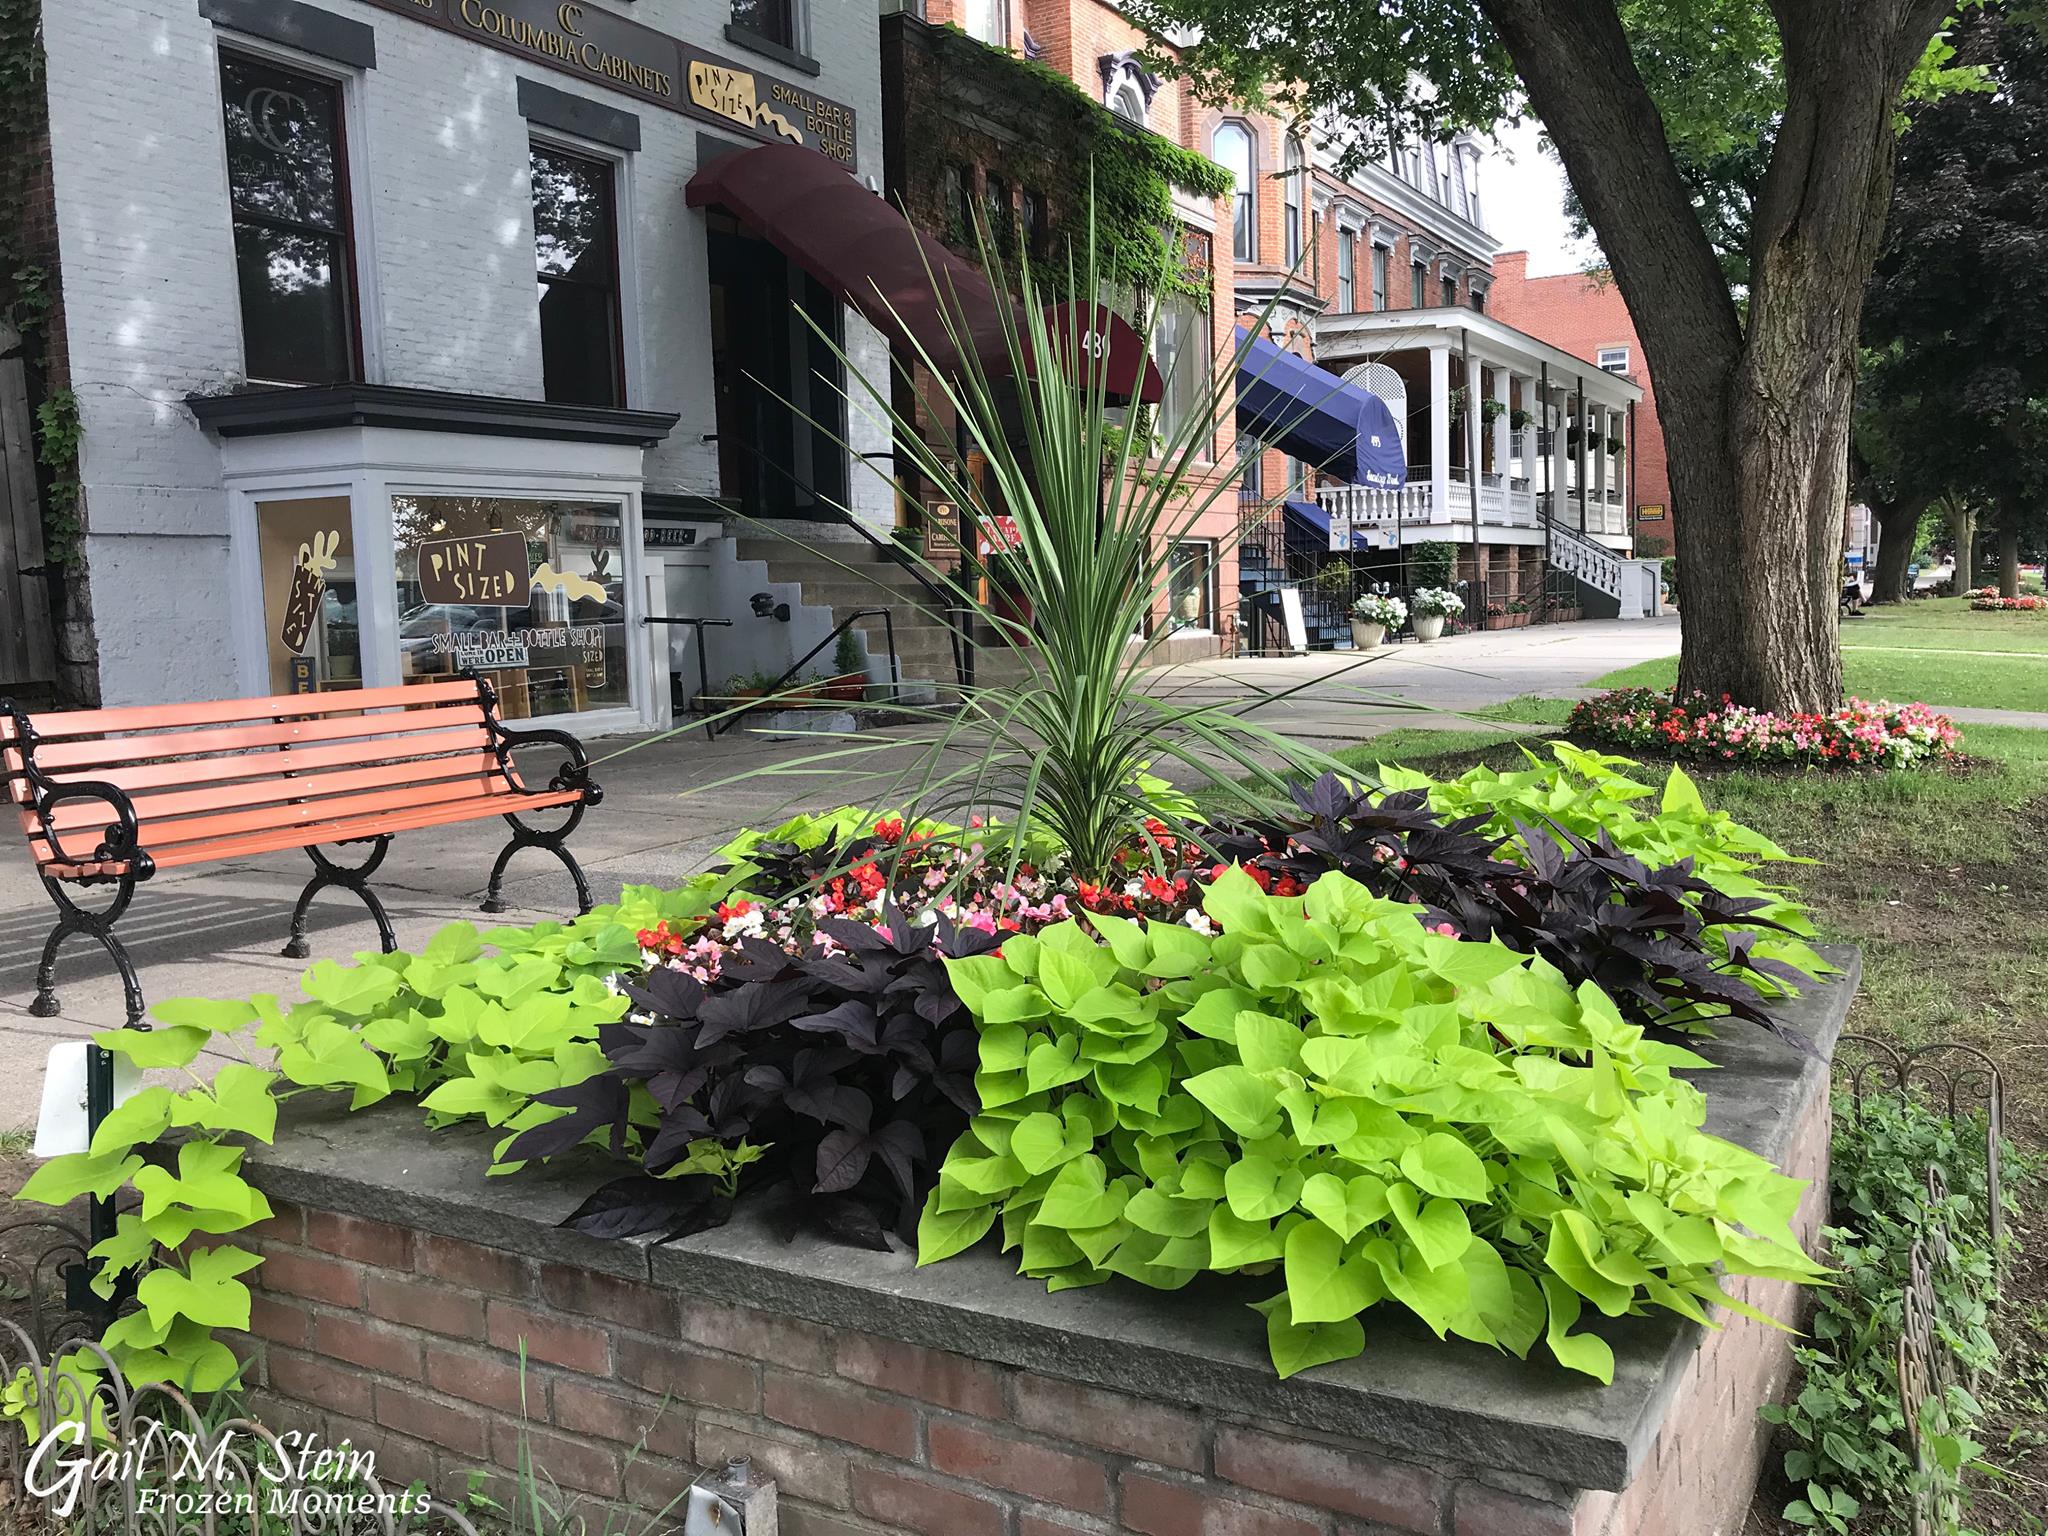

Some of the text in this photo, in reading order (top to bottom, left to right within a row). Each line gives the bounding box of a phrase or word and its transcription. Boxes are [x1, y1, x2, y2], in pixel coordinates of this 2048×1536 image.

[557, 4, 584, 36] CC
[582, 43, 671, 96] CABINETS
[695, 68, 734, 95] PINT
[711, 89, 752, 121] SIZED
[772, 85, 852, 127] SMALL BAR &
[806, 117, 852, 145] BOTTLE
[820, 139, 853, 161] SHOP
[431, 543, 486, 581] PINT
[454, 570, 515, 600] SIZED
[432, 632, 476, 654] SMALL
[570, 627, 600, 647] SHOP
[461, 648, 525, 664] WE'RE OPEN
[583, 650, 603, 663] SIZED
